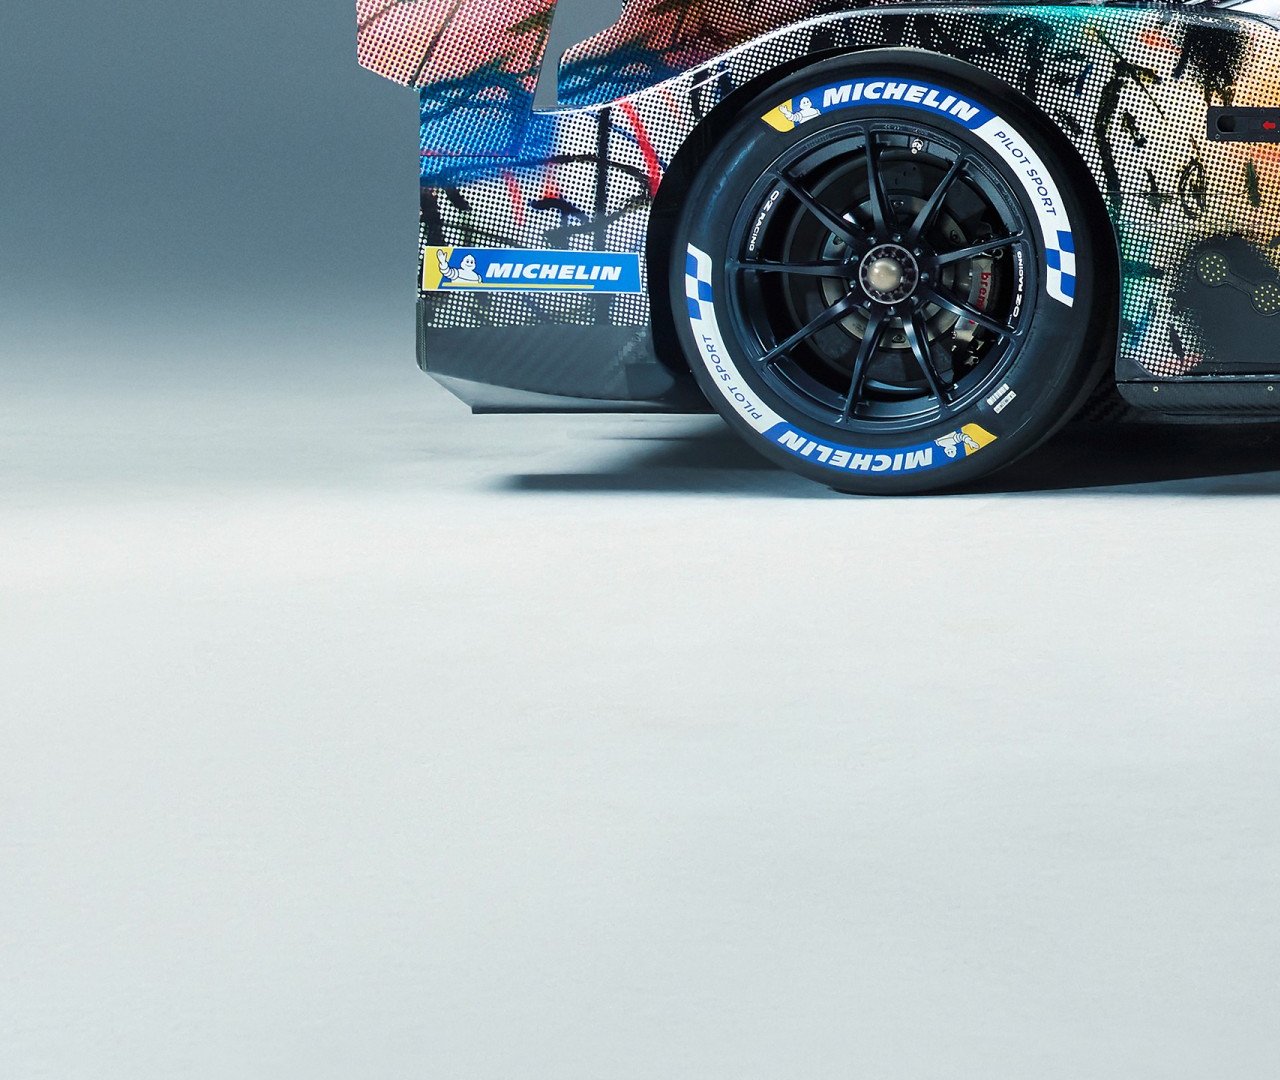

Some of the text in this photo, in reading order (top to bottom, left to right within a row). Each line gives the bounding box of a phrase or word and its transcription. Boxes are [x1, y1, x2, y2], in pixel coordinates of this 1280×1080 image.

[822, 81, 980, 122] MICHELIN
[993, 130, 1030, 165] PILOT
[1027, 168, 1057, 216] SPORT
[749, 211, 766, 251] RACING
[485, 263, 622, 281] MICHELIN
[702, 334, 763, 420] PILOT SPORT
[778, 430, 933, 472] MICHELIN
